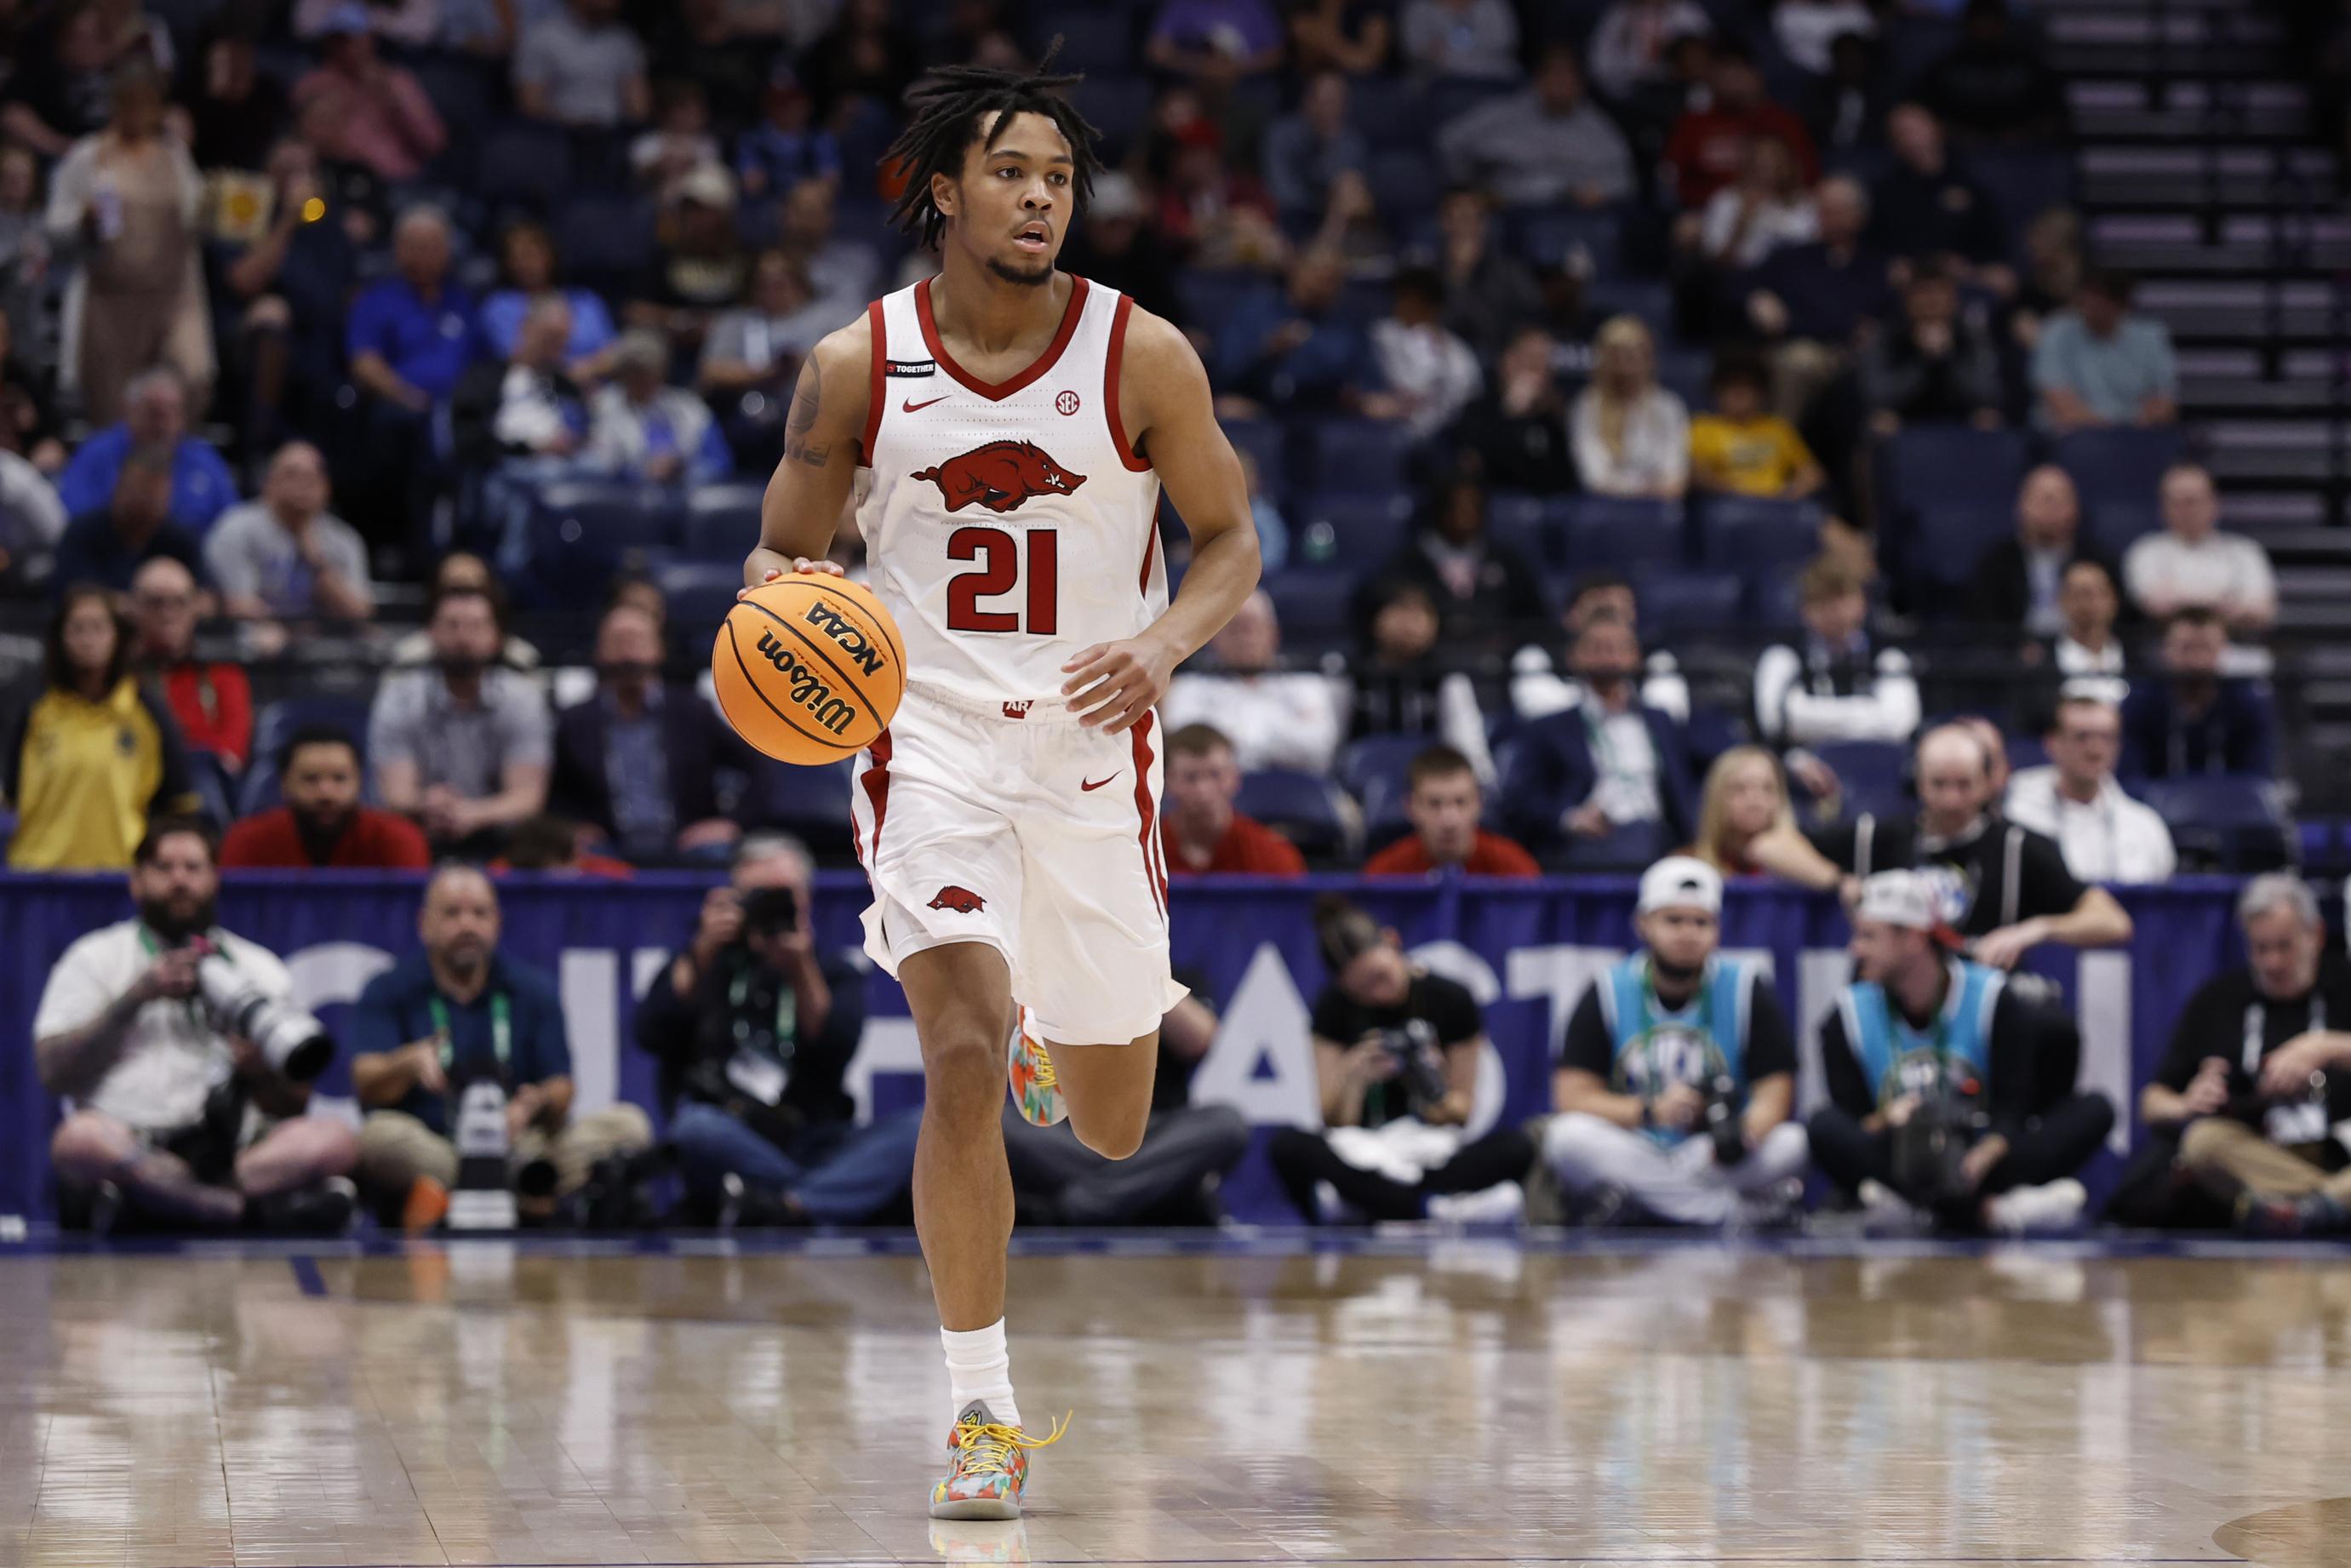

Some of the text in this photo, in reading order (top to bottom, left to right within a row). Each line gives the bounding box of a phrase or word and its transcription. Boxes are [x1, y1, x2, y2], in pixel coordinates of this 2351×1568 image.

[895, 363, 934, 373] TOGETHER
[1056, 392, 1079, 415] SEC
[947, 526, 1058, 635] 21
[804, 601, 884, 678] NCAA
[756, 629, 856, 735] Wilson
[1005, 700, 1029, 713] AR
